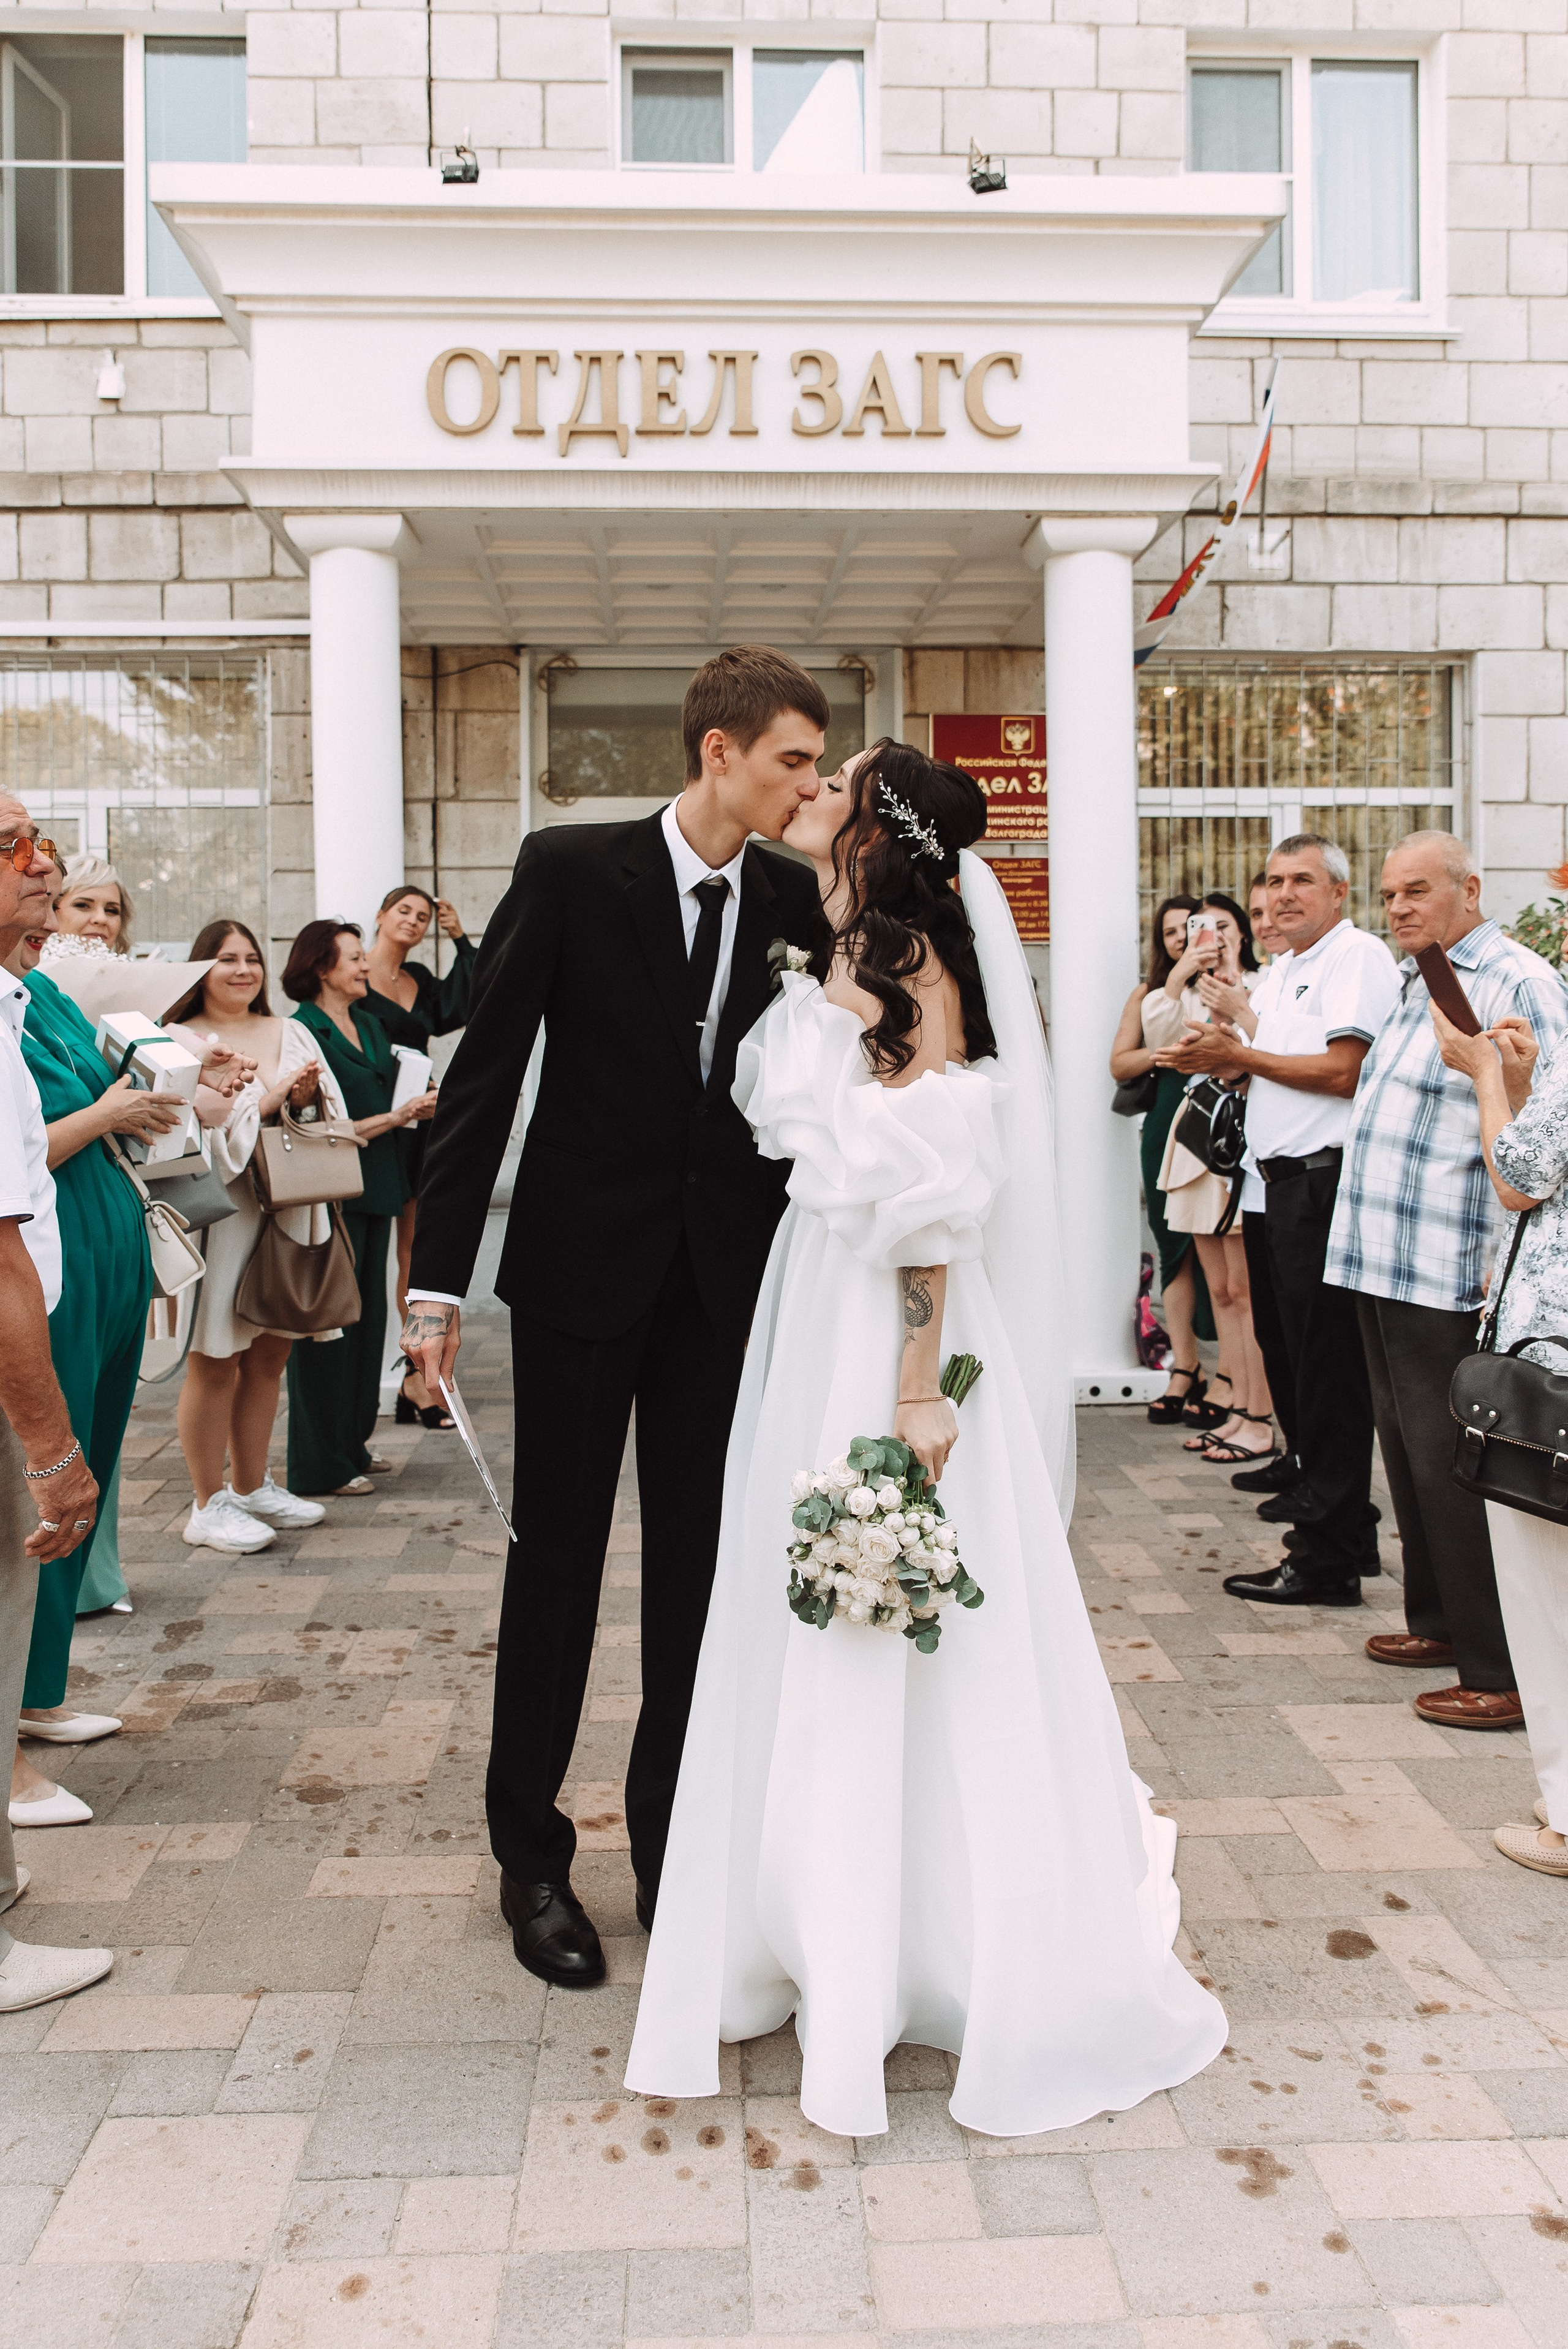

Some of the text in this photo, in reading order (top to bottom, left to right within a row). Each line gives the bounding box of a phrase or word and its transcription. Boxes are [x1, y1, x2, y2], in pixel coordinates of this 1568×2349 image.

[426, 347, 1023, 458] ОТДЕЛ ЗАГС
[955, 756, 1017, 767] Российская
[978, 775, 1022, 797] дел
[987, 804, 1047, 815] министрац
[987, 816, 1036, 826] инского
